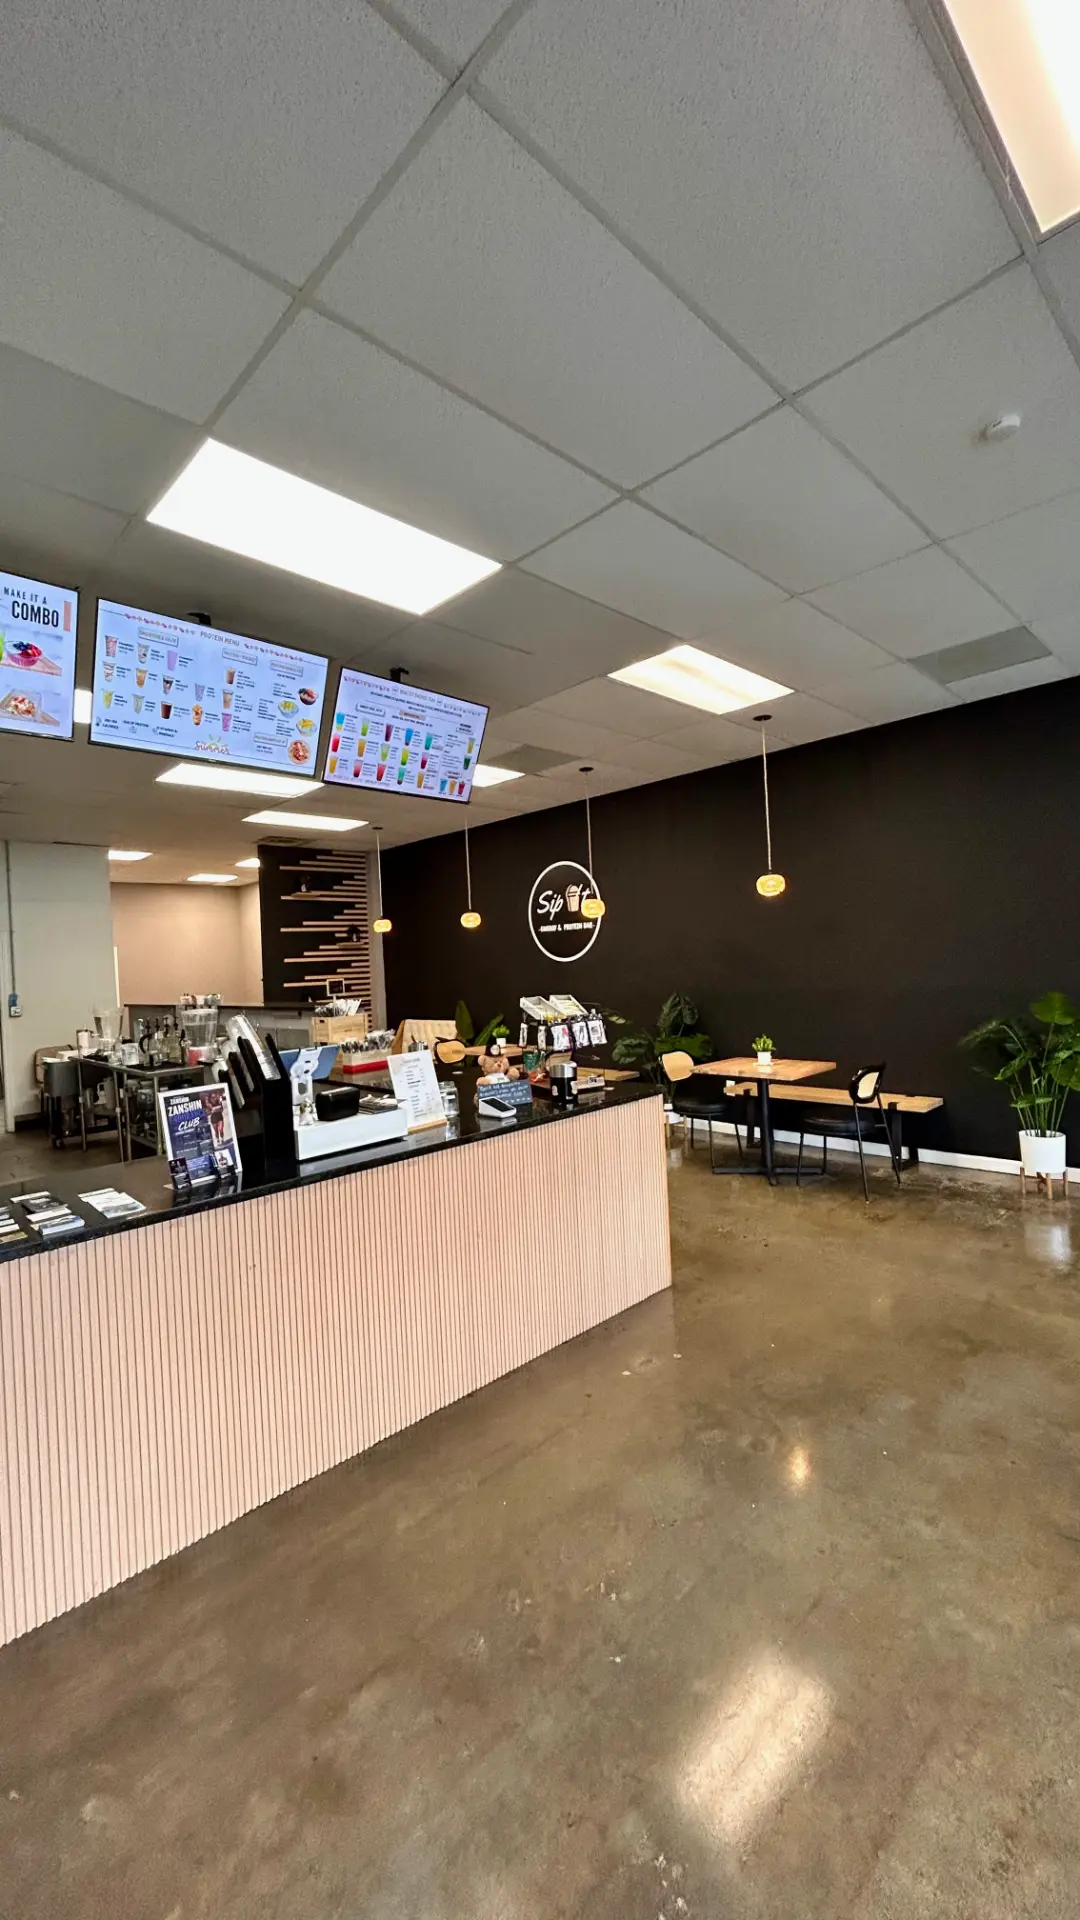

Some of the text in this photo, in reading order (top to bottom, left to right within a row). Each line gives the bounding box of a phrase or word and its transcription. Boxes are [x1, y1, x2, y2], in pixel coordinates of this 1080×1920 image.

[4, 587, 47, 605] MAKE IT A
[12, 600, 59, 628] COMBO
[200, 630, 240, 647] PROTEIN MENU
[194, 740, 229, 755] Summer
[537, 890, 564, 921] Sip
[167, 1099, 202, 1117] ZANSHIN
[178, 1116, 200, 1131] CLUB
